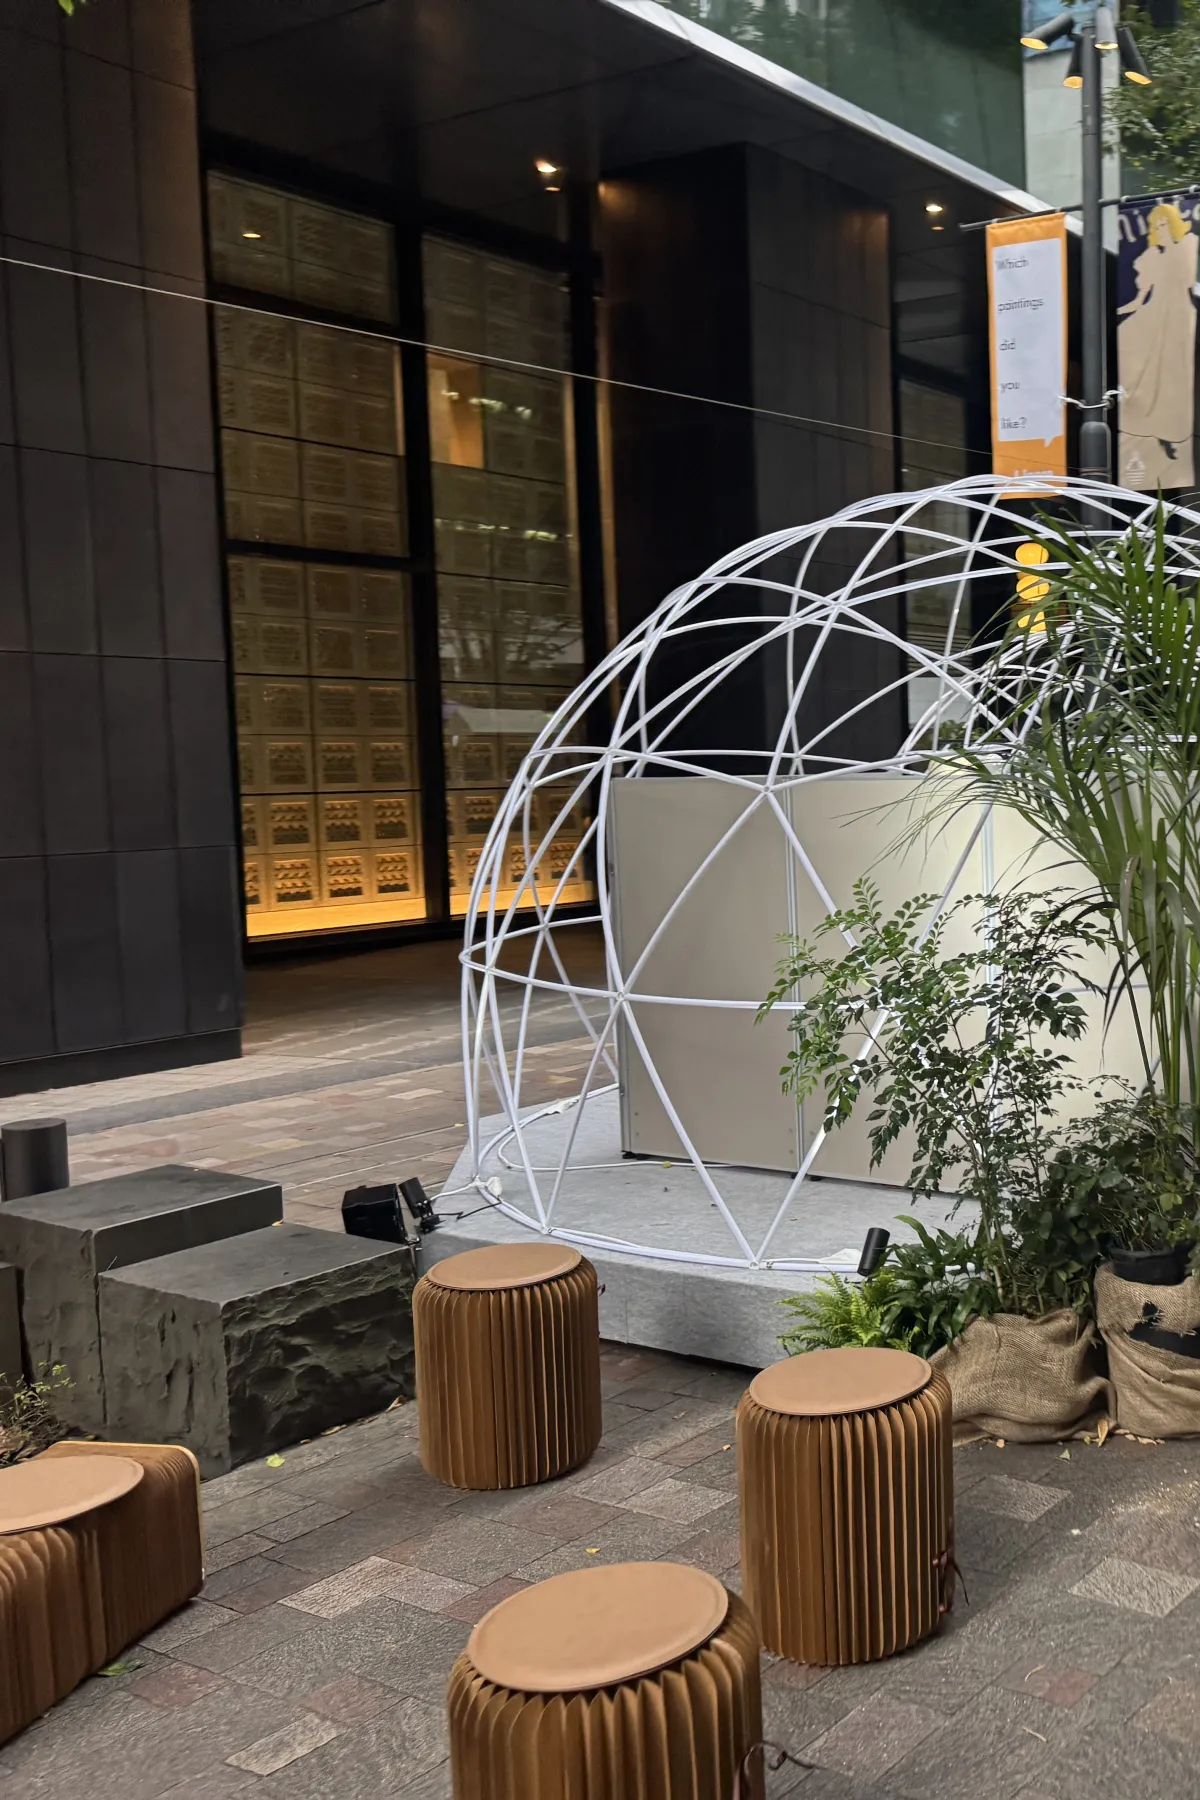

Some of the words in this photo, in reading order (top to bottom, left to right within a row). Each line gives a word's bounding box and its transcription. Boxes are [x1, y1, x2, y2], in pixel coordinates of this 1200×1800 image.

[999, 337, 1016, 351] did
[1000, 382, 1020, 394] you
[1001, 417, 1027, 429] like?
